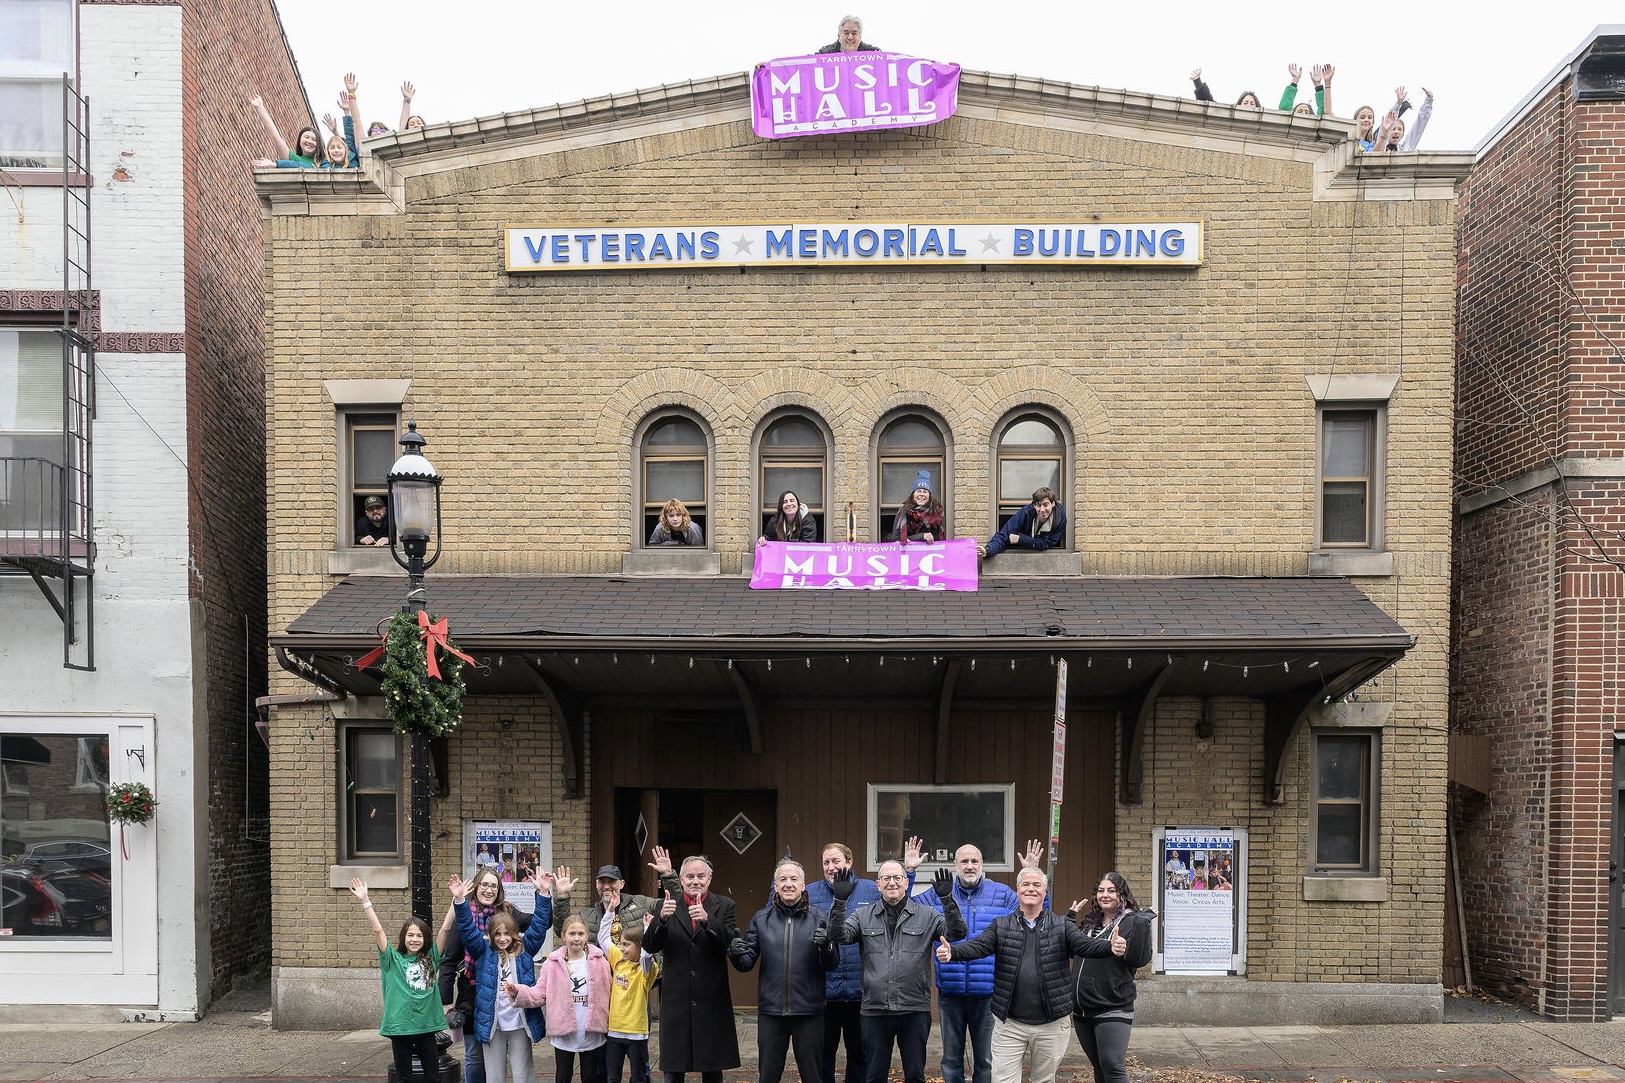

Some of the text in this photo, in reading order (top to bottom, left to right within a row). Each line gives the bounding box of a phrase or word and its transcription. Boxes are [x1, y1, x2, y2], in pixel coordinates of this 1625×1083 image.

[820, 54, 883, 64] TARRYTOWN
[770, 60, 933, 95] MUSIC
[772, 88, 936, 123] HALL
[793, 116, 918, 131] ACADEMY
[524, 228, 1186, 262] VETERANS MEMORIAL BUILDING
[835, 545, 896, 553] TARRYTOWN
[784, 554, 945, 576] MUSIC
